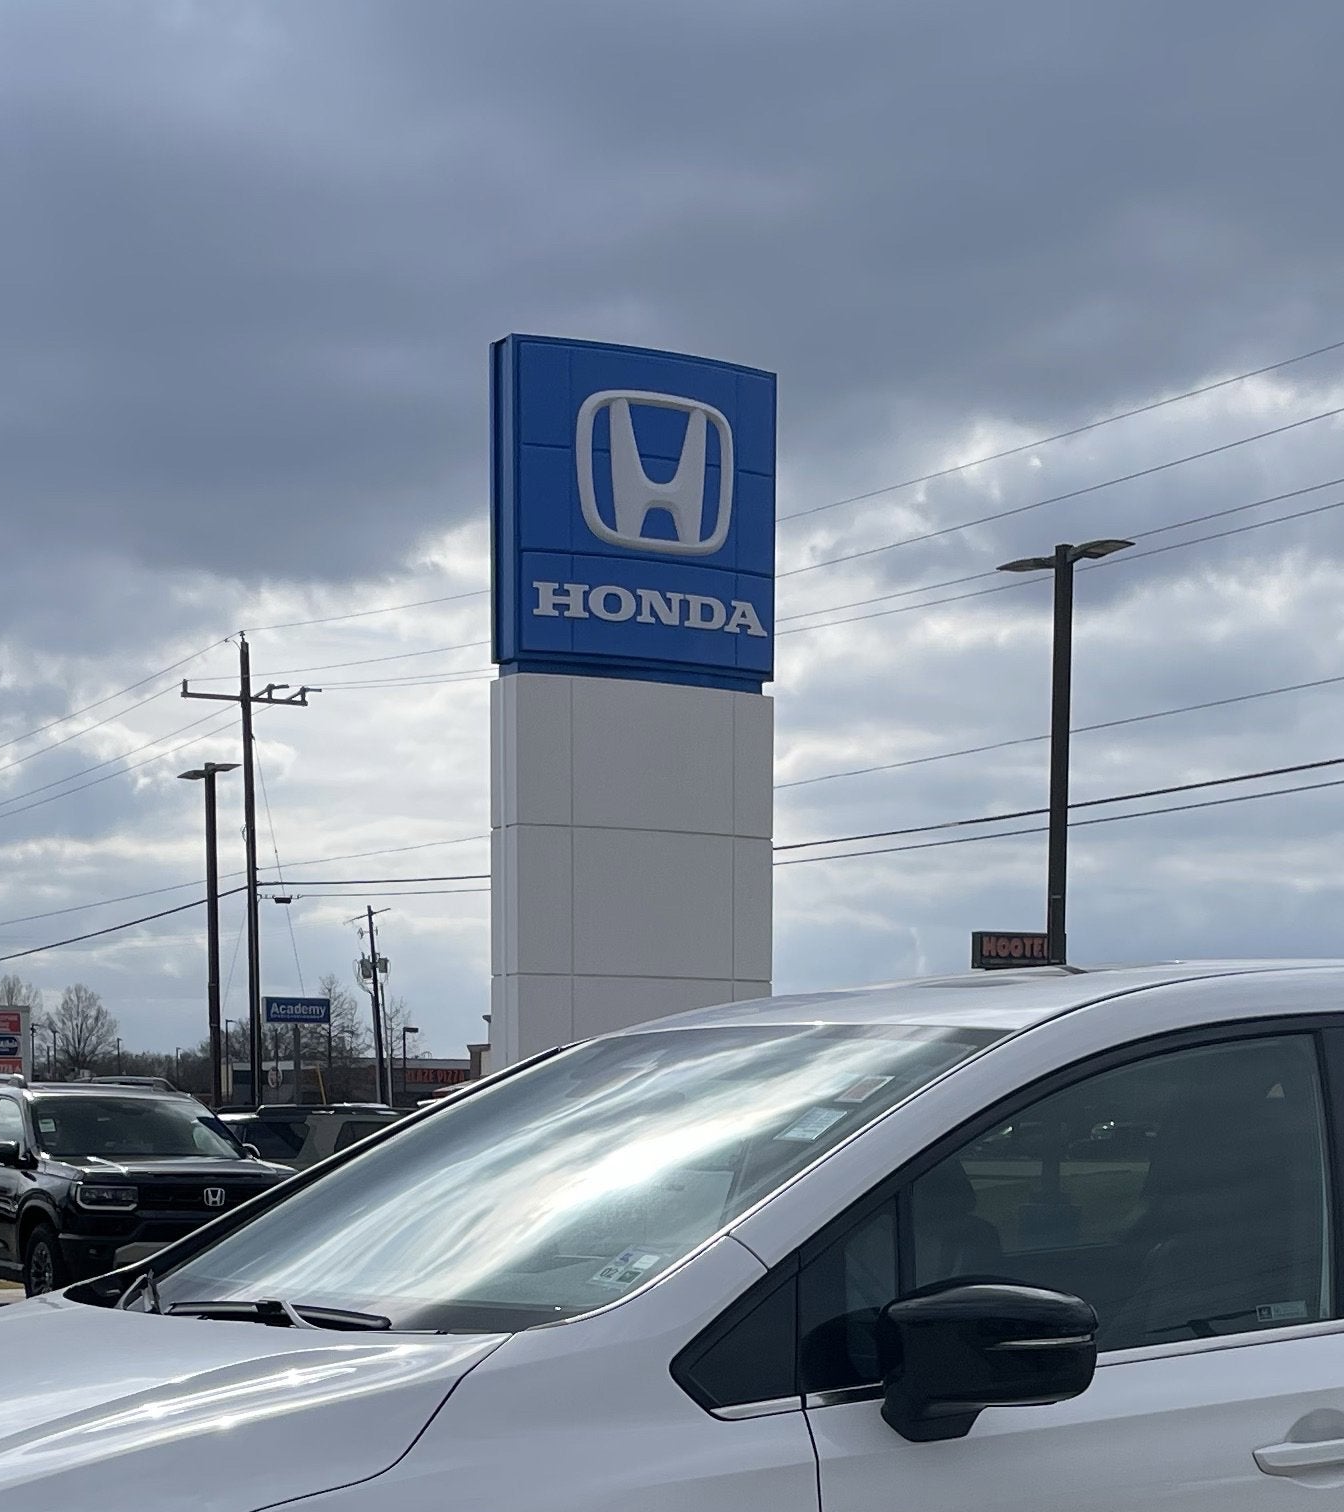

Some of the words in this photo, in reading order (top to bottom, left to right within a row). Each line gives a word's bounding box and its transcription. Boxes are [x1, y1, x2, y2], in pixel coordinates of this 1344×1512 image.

[532, 580, 768, 637] HONDA
[982, 936, 1048, 958] HOOTE
[270, 1002, 326, 1018] Academy
